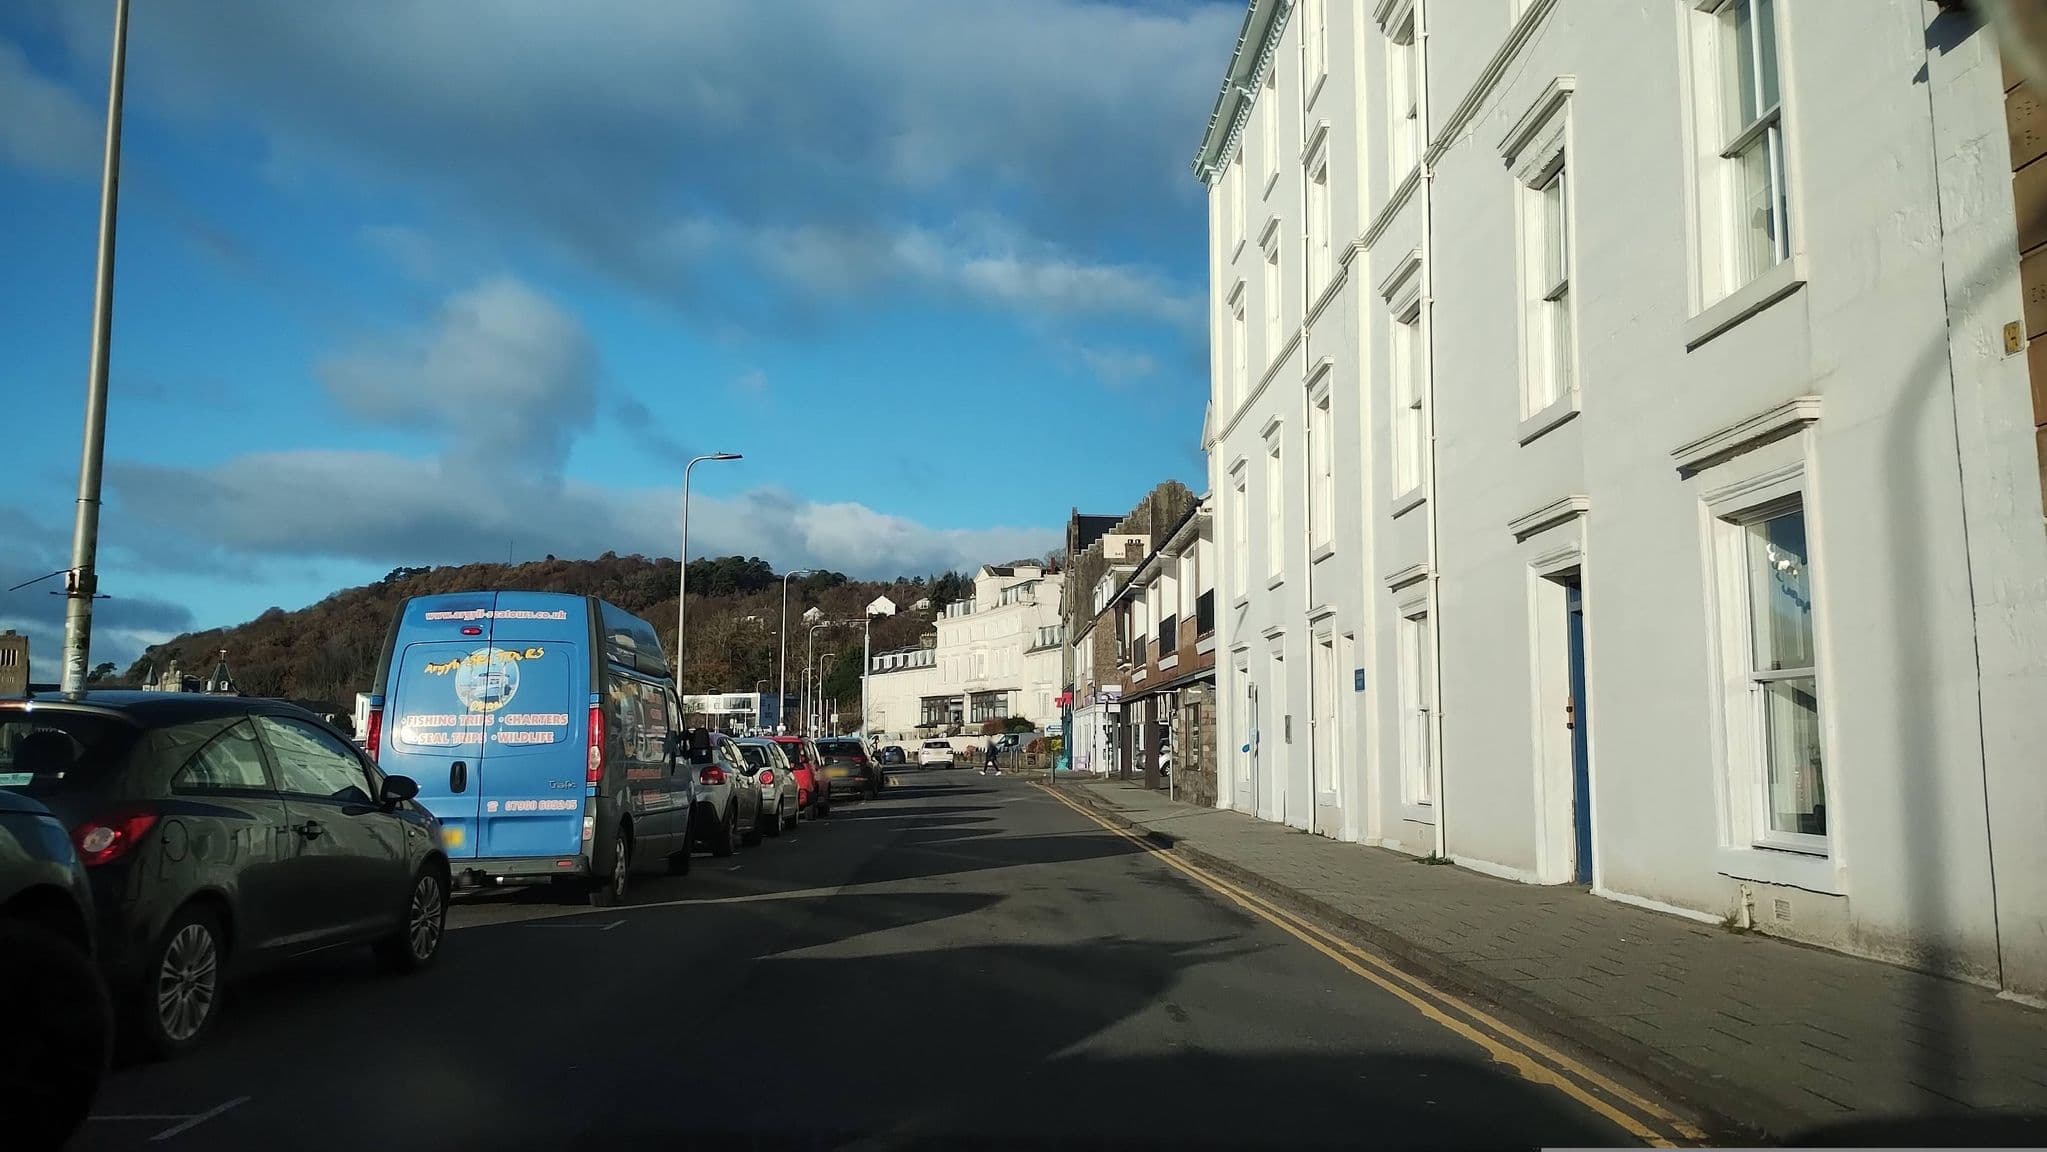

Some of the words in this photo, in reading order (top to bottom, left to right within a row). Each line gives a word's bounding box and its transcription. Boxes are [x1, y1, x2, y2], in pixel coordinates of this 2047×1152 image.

[406, 715, 456, 726] FISHING
[459, 714, 494, 726] TRIPS
[504, 713, 568, 726] CHARTERS
[417, 732, 449, 744] SEAL
[496, 731, 555, 743] WILDLIFE
